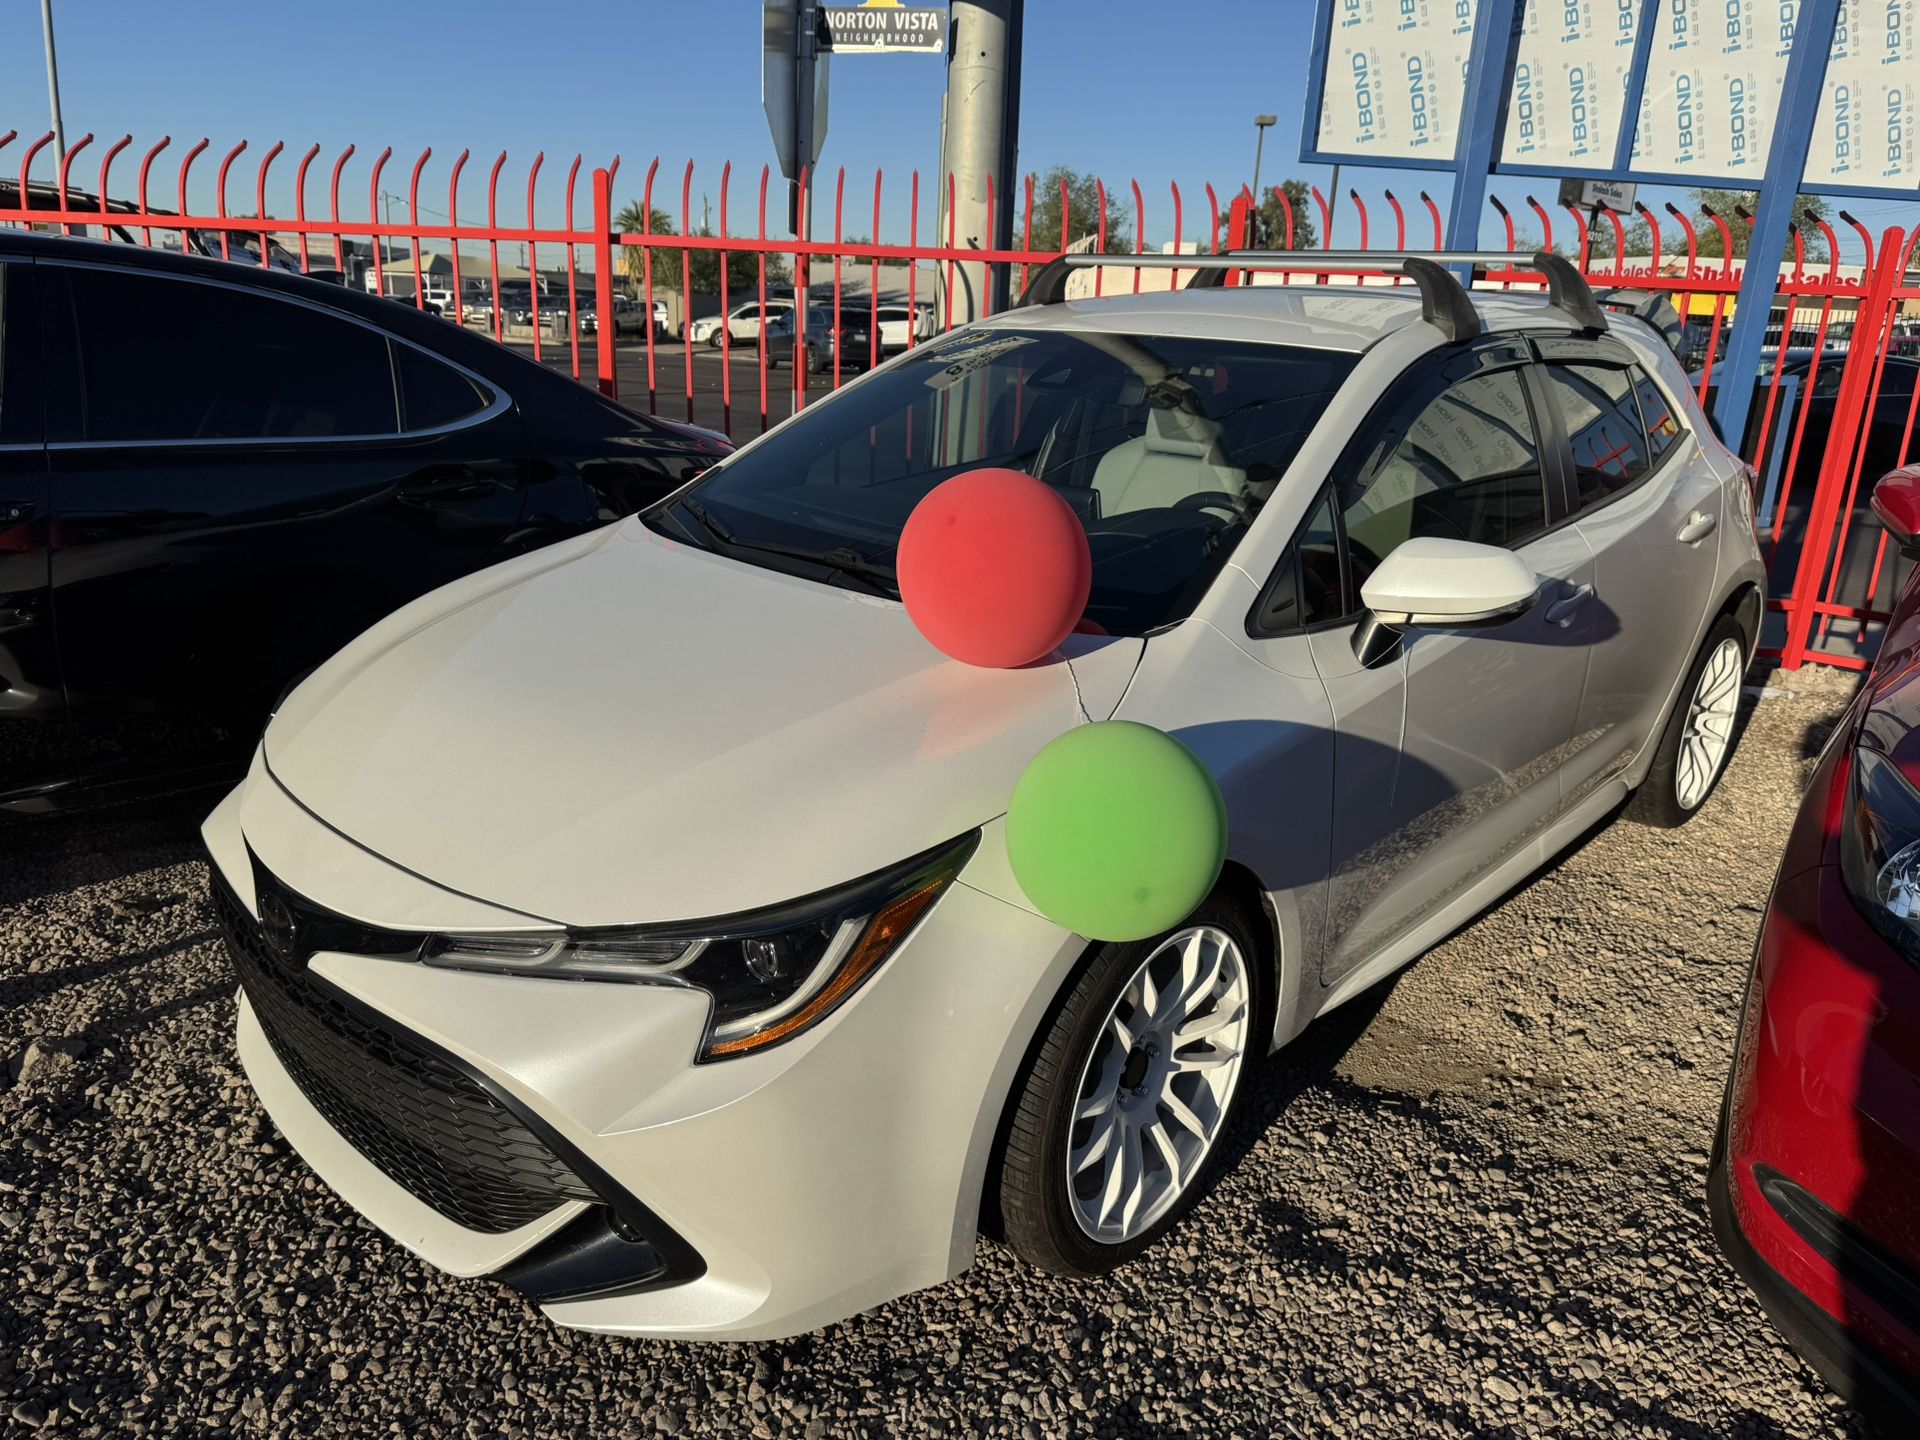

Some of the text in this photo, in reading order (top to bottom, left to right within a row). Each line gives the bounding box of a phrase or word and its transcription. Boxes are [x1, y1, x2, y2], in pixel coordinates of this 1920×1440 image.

[825, 11, 938, 30] NORTON VISTA
[835, 32, 924, 43] NEIGHBORHOOD
